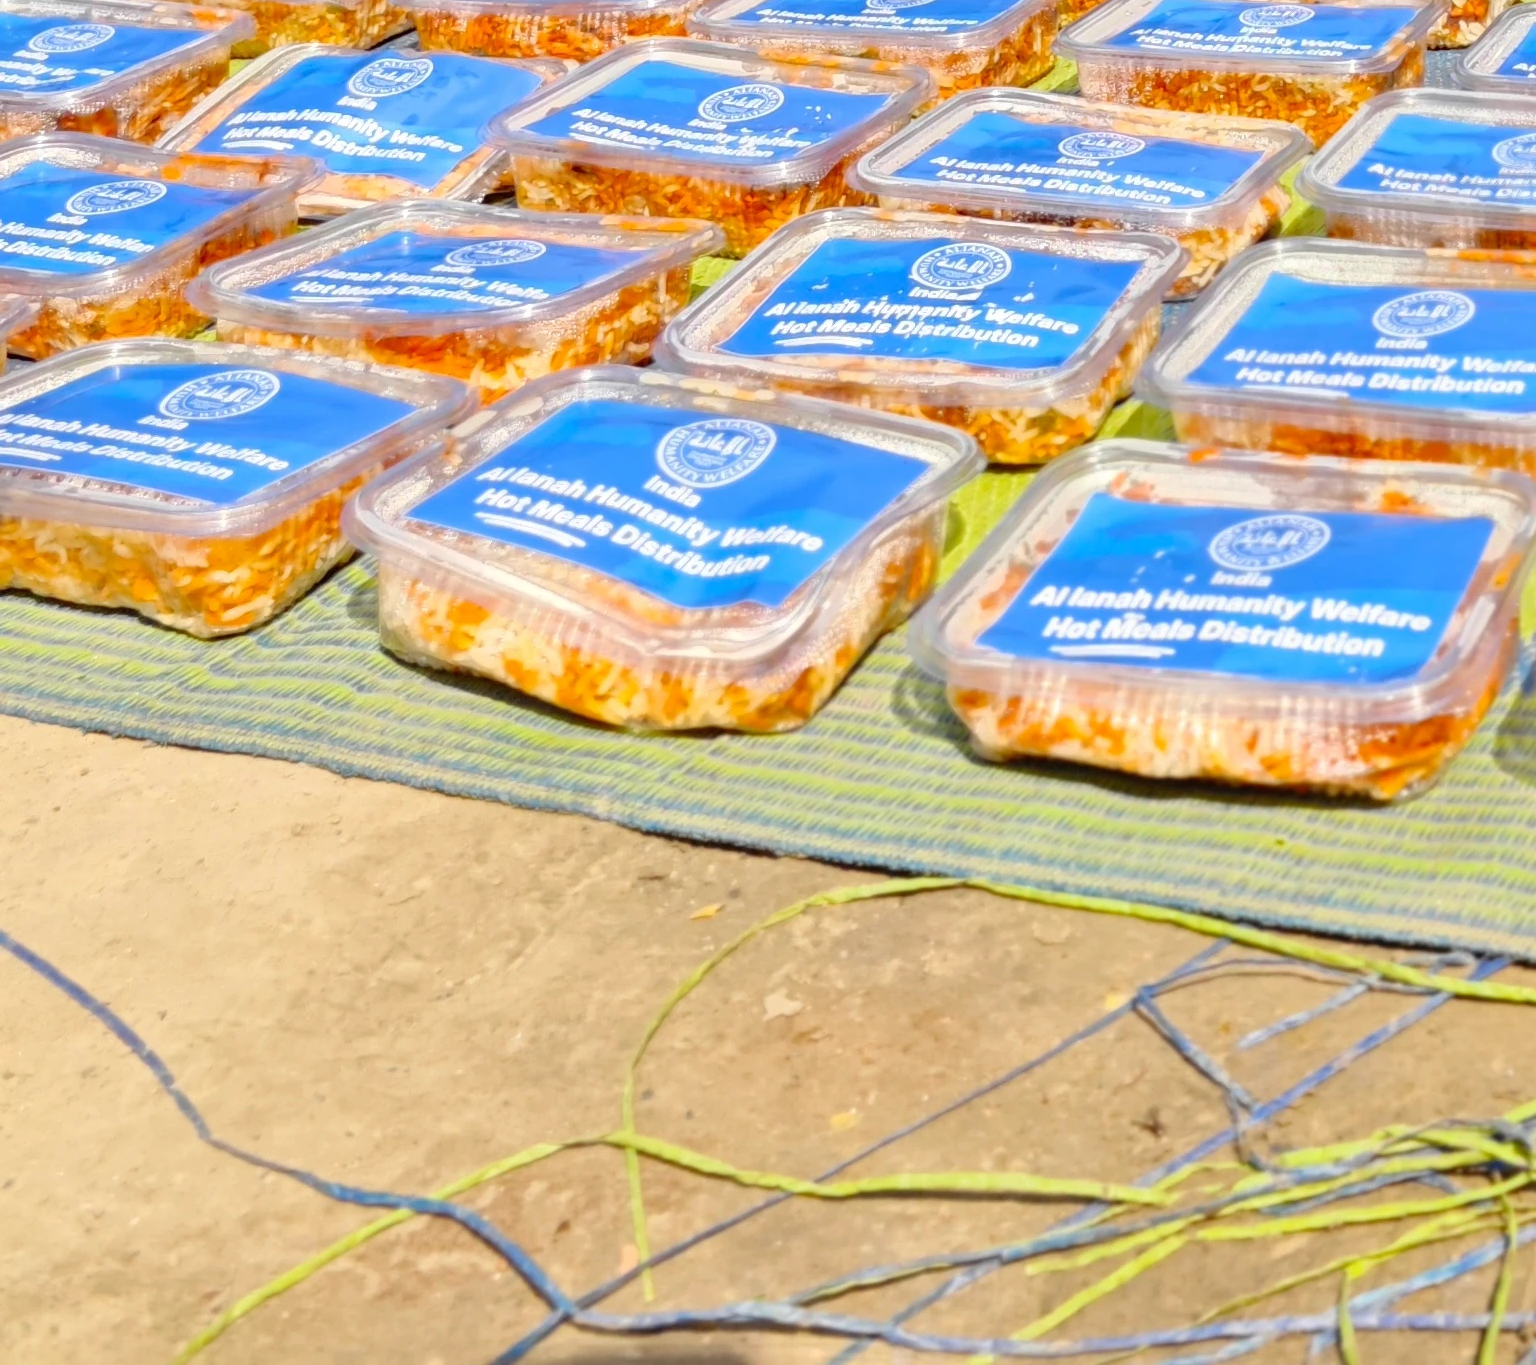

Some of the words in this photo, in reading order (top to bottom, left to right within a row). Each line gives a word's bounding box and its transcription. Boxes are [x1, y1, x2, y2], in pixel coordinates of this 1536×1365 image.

[223, 127, 259, 142] Hot
[255, 127, 313, 143] Meals
[311, 130, 425, 161] Distribution
[226, 109, 252, 125] Al
[295, 109, 390, 141] Humanity
[389, 130, 462, 152] Welfare
[930, 157, 959, 168] Al
[1017, 164, 1120, 183] Humanity
[1124, 175, 1205, 198] Welfare
[937, 170, 976, 184] Hot
[977, 174, 1042, 186] Meals
[1044, 180, 1170, 204] Distribution
[909, 286, 963, 300] India
[764, 303, 796, 316] Al
[861, 299, 982, 326] Humanity
[985, 305, 1079, 334] Welfare
[771, 321, 817, 335] Hot
[815, 319, 891, 337] Meals
[892, 321, 1039, 347] Distribution
[1376, 336, 1427, 349] India
[1224, 349, 1256, 363] Al
[1329, 352, 1457, 373] Humanity
[1236, 368, 1284, 383] Hot
[1286, 370, 1365, 387] Meals
[1368, 373, 1524, 394] Distribution
[0, 429, 24, 443] ot
[18, 434, 93, 452] Meals
[89, 445, 233, 479] Distribution
[77, 424, 195, 451] Humanity
[195, 443, 289, 470] Welfare
[645, 478, 701, 506] India
[477, 468, 512, 481] Al
[584, 485, 720, 544] Humanity
[720, 526, 823, 552] Welfare
[476, 489, 531, 512] Hot
[527, 500, 613, 536] Meals
[610, 525, 770, 577] Distribution
[1211, 571, 1271, 587] India
[1030, 586, 1069, 606] Al
[1154, 591, 1306, 621] Humanity
[1311, 599, 1431, 631] Welfare
[1043, 618, 1101, 639] Hot
[1102, 619, 1195, 639] Meals
[1198, 622, 1384, 656] Distribution
